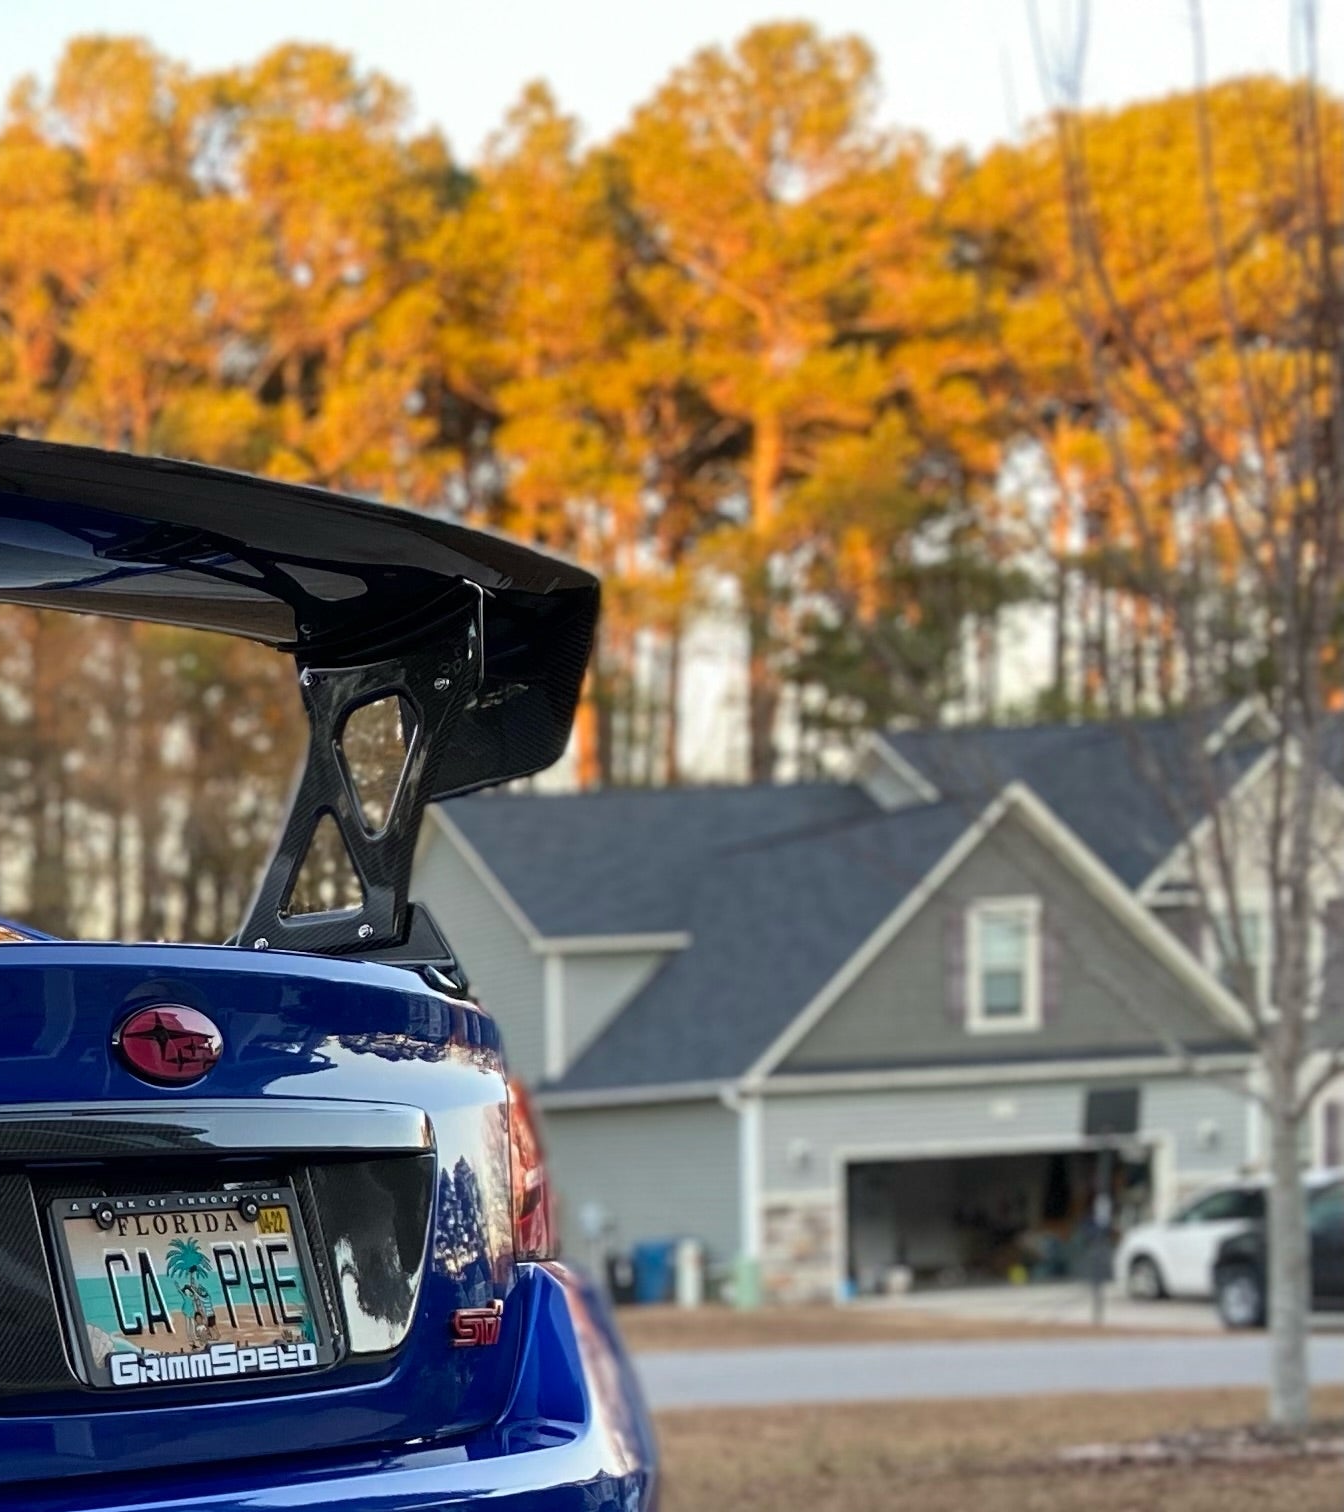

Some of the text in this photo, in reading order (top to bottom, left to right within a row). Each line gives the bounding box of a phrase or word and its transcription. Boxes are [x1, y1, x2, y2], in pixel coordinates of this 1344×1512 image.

[71, 1203, 80, 1212] A
[91, 1200, 136, 1211] MRK
[148, 1199, 166, 1208] OF
[116, 1212, 238, 1237] FLORIDA
[104, 1239, 305, 1336] CA PHE
